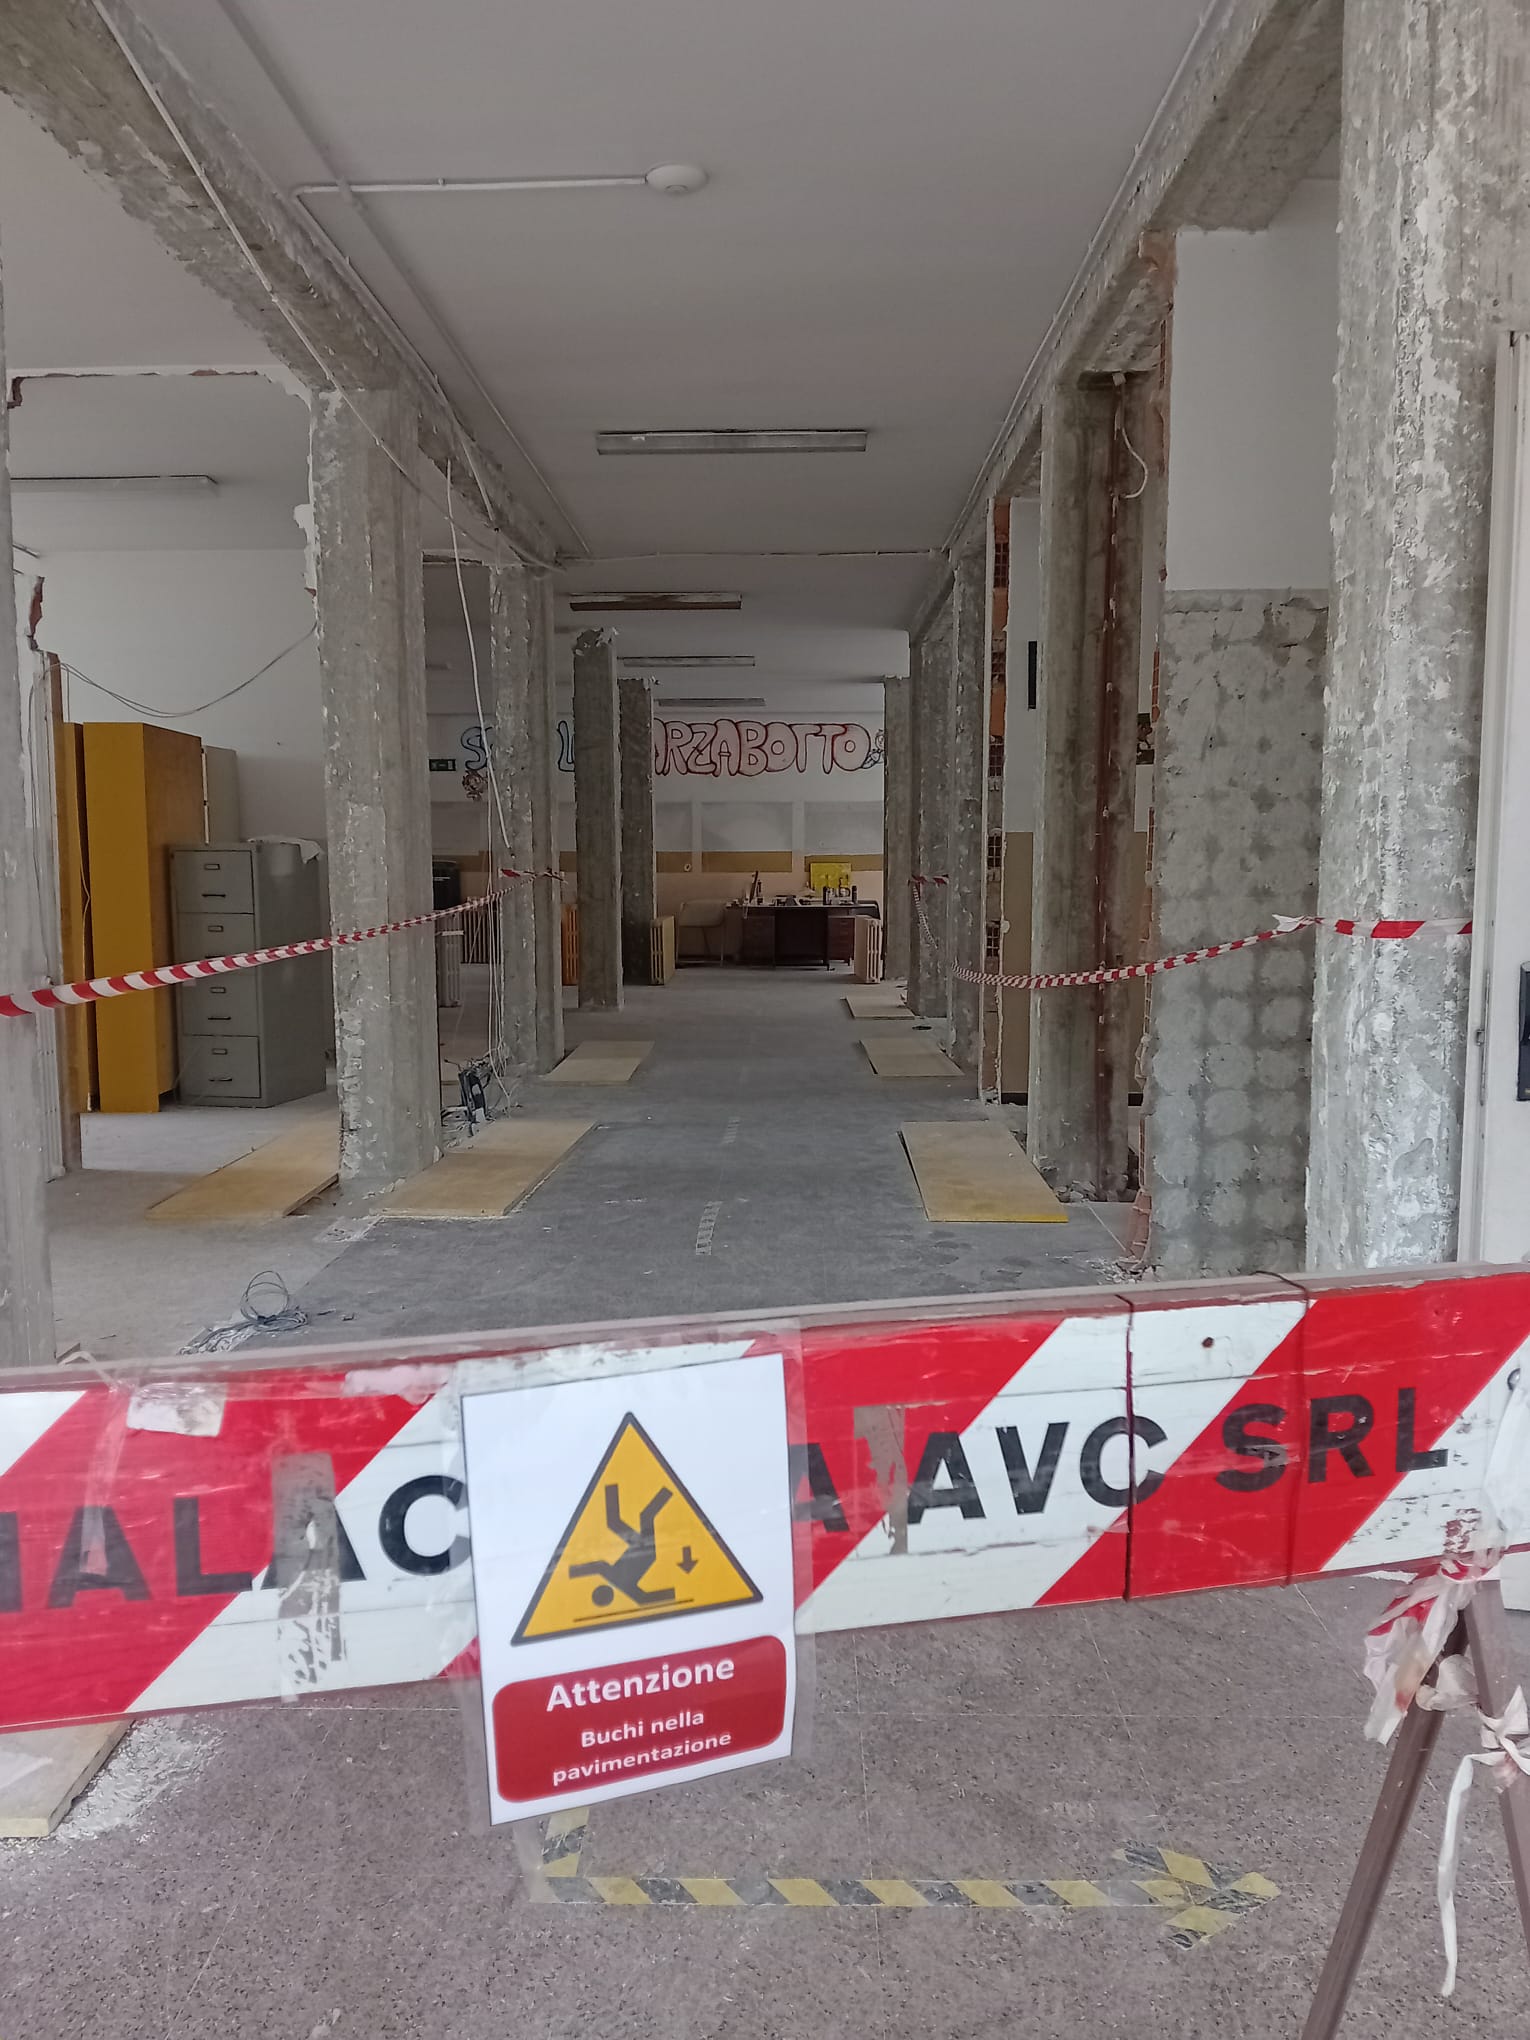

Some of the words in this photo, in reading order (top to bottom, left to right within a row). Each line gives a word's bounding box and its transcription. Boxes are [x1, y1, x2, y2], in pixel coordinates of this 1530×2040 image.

[907, 1414, 1168, 1524] AVC
[1215, 1387, 1448, 1493] SRL
[546, 1657, 735, 1712] Attenzione
[580, 1720, 644, 1748] Buchi
[651, 1710, 704, 1735] nella
[552, 1732, 732, 1786] pavimentazione
